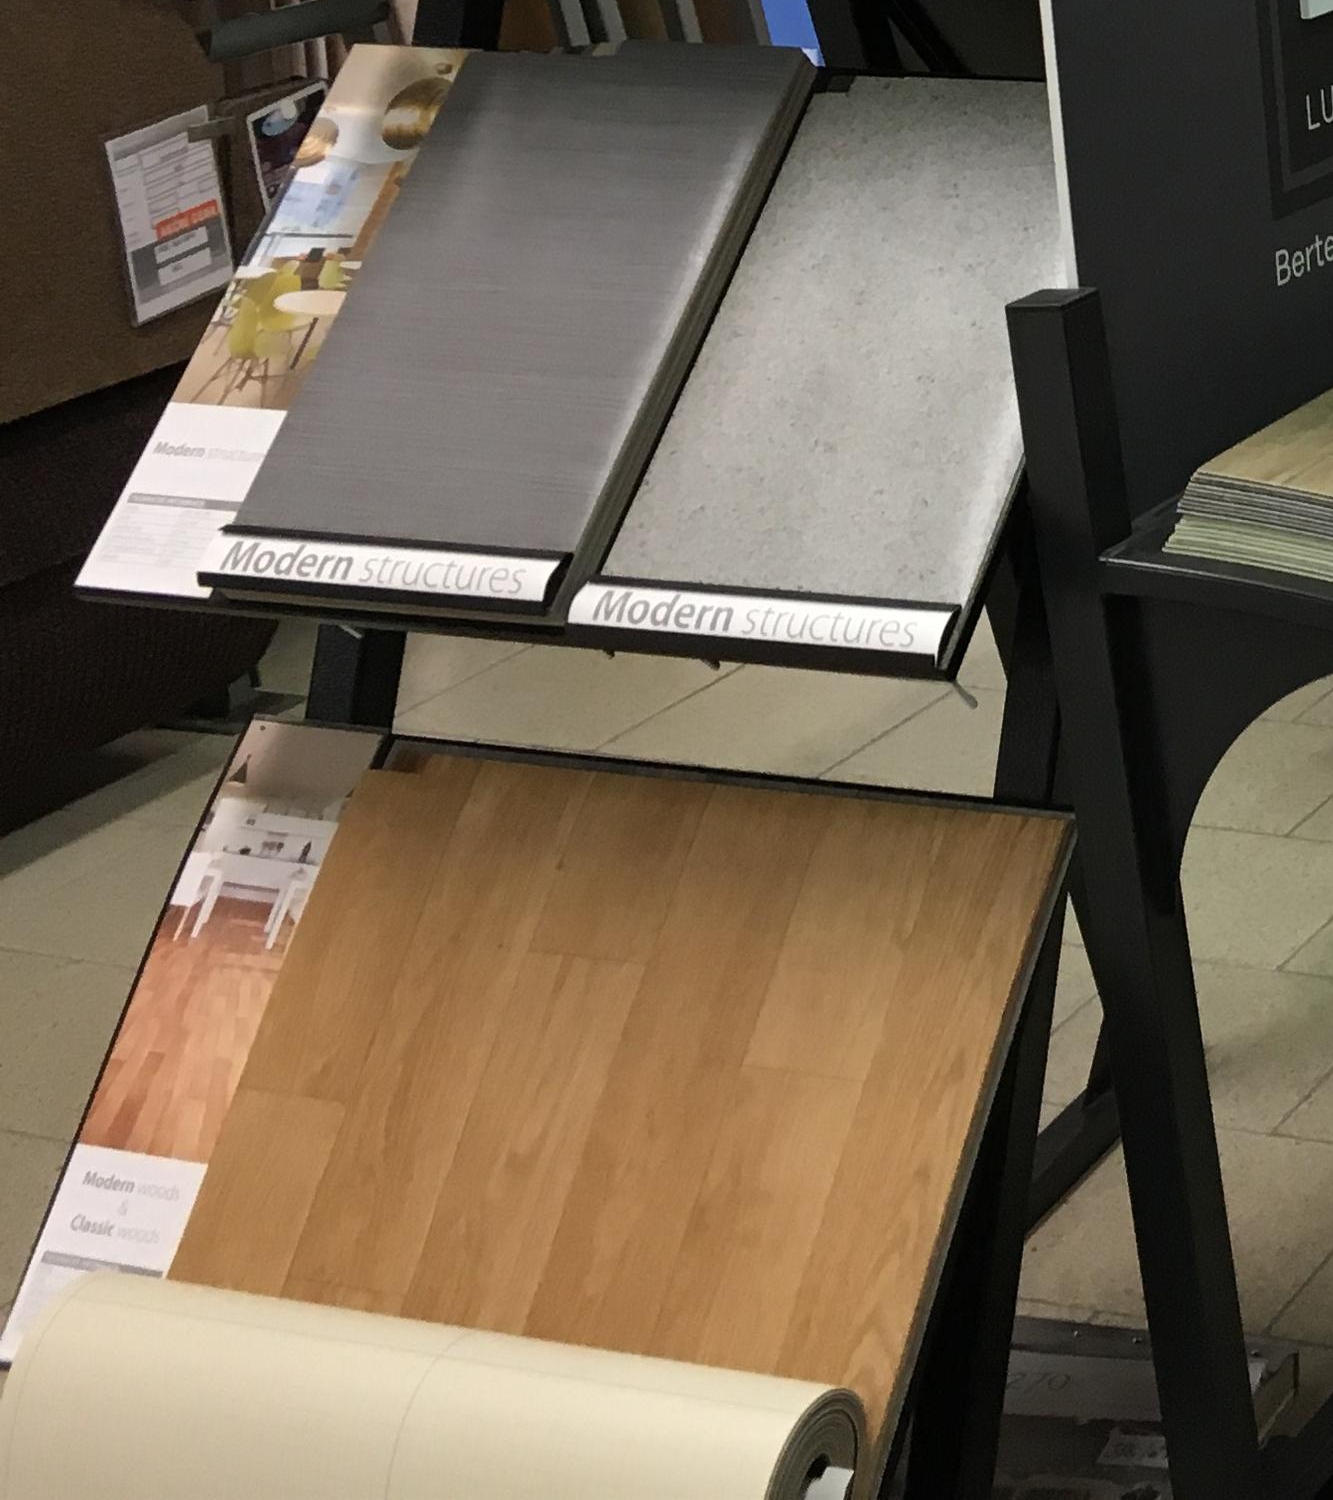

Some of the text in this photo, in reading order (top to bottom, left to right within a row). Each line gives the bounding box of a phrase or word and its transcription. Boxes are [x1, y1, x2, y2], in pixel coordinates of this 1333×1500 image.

[153, 441, 206, 458] Modern
[221, 540, 527, 595] Modern structures
[592, 589, 917, 648] Modern structures
[83, 1171, 135, 1193] Modern
[70, 1213, 115, 1236] Classic
